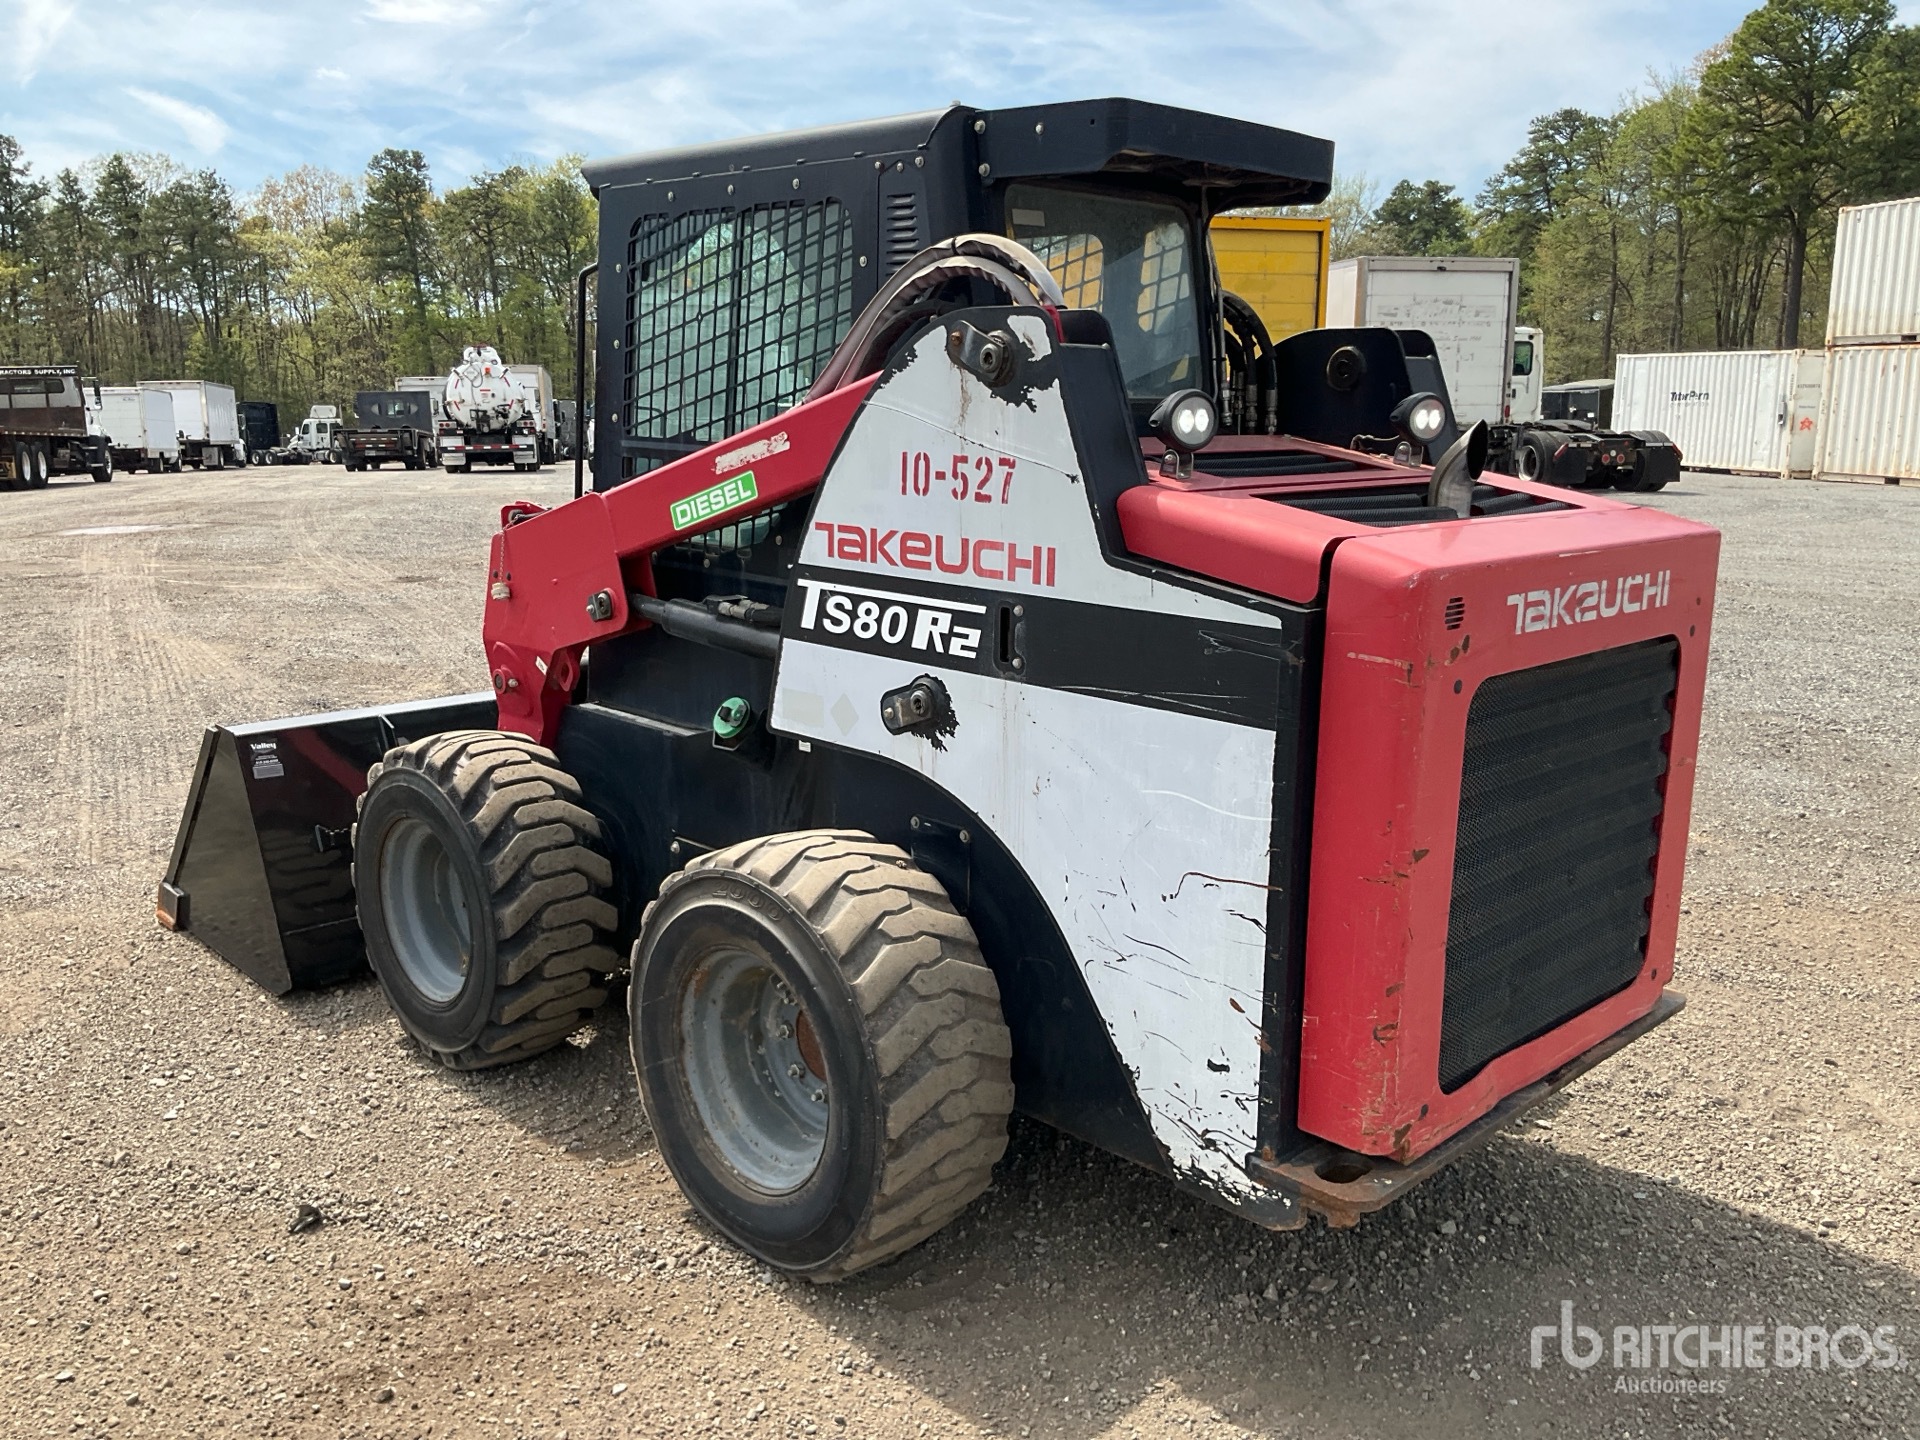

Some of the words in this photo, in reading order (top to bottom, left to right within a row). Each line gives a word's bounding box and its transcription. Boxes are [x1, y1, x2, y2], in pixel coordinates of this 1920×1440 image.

[901, 451, 1016, 504] 10-527
[675, 480, 752, 525] DIESEL
[250, 742, 277, 750] Valley
[712, 882, 784, 921] 2000
